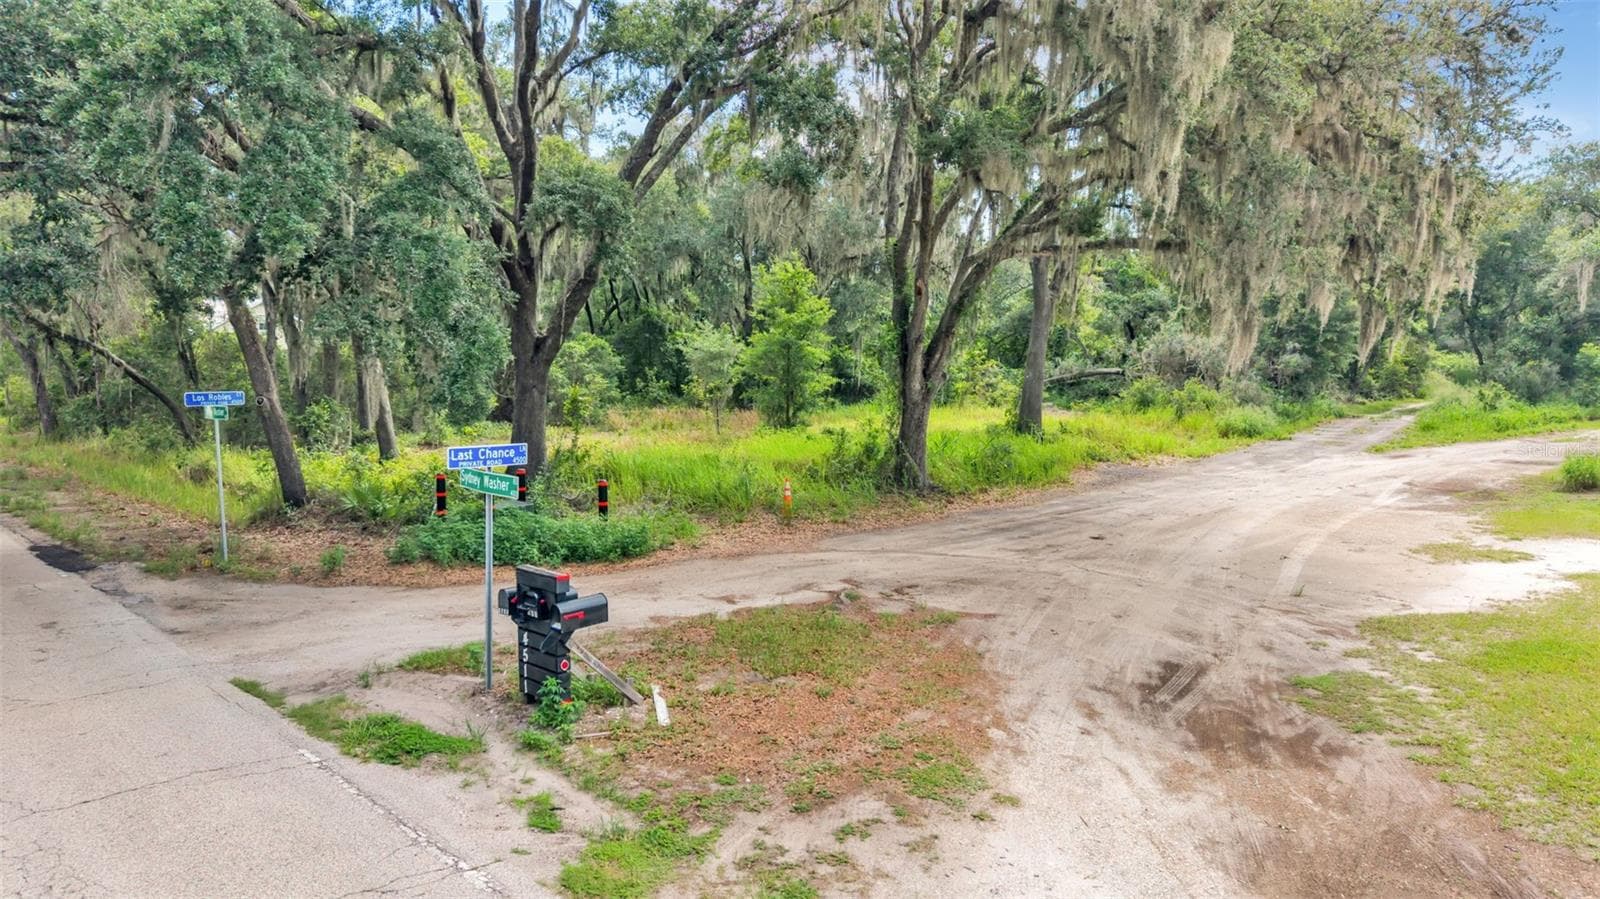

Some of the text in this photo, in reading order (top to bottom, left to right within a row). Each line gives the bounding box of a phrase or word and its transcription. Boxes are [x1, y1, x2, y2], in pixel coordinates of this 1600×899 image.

[192, 393, 232, 402] Los Robles
[450, 447, 515, 461] Last Chance
[458, 458, 503, 468] PRIVATE ROAD
[460, 469, 510, 491] Sydney Washer
